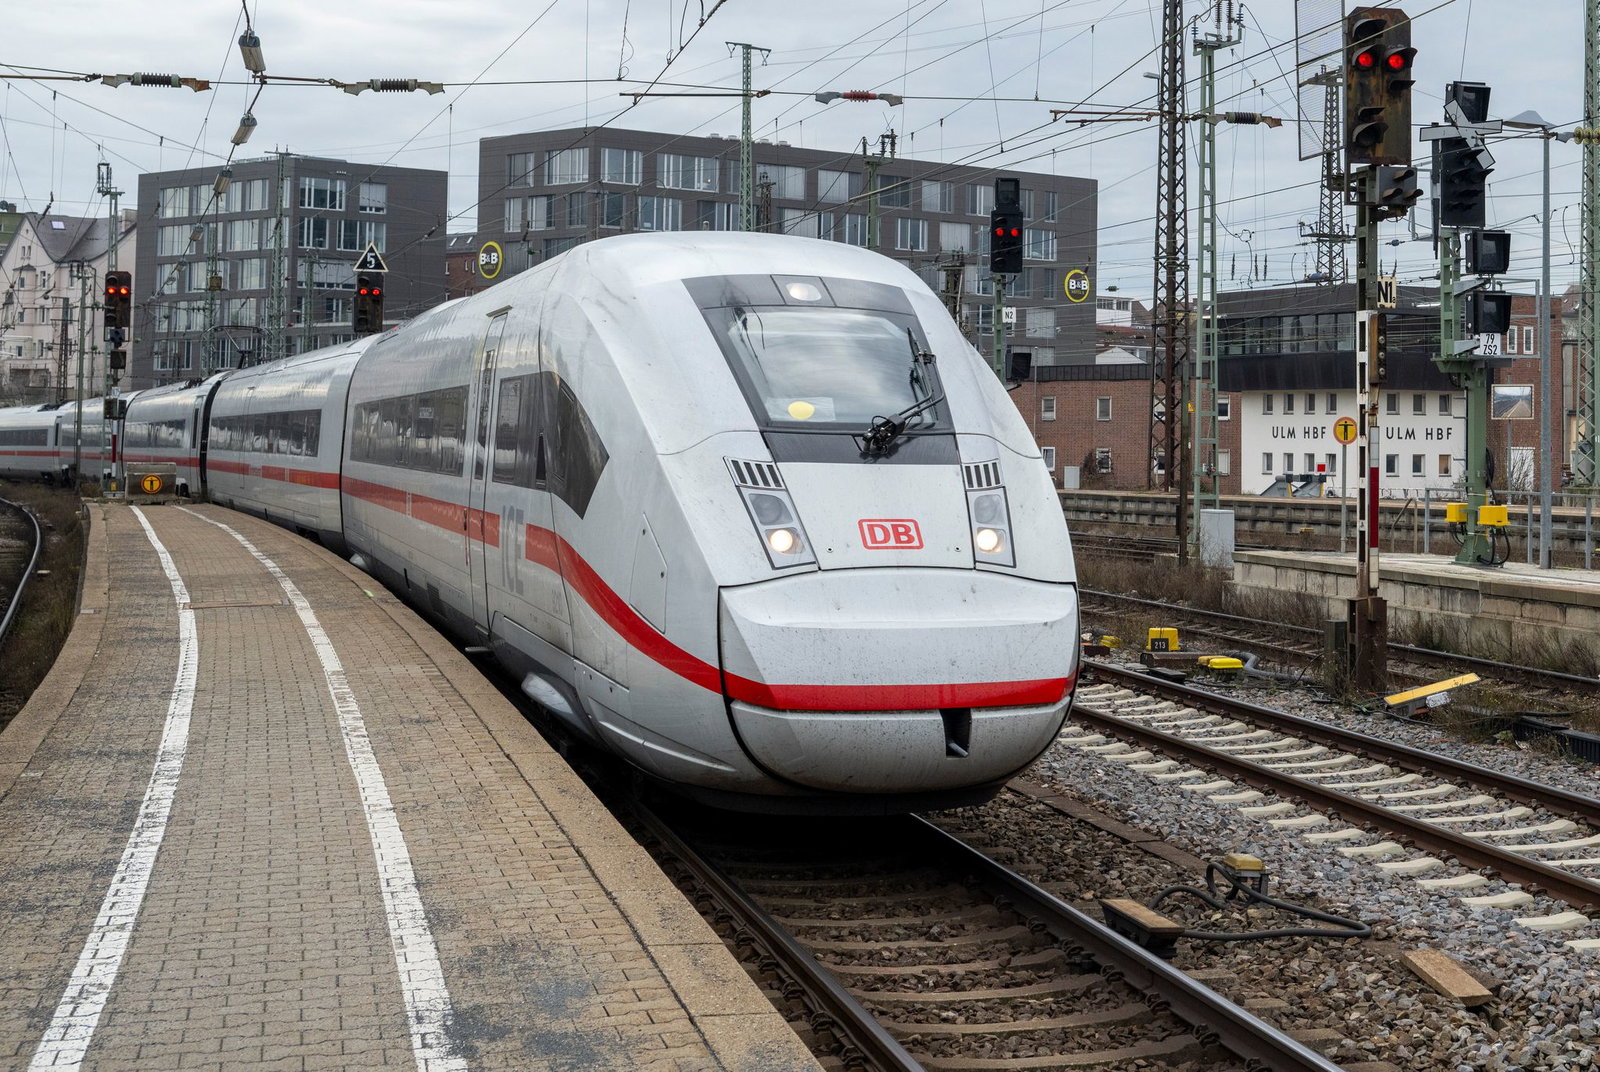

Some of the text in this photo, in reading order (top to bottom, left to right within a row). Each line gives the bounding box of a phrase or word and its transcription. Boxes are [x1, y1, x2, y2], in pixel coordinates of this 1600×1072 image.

[366, 252, 376, 269] 5
[480, 252, 498, 265] B&B
[1069, 279, 1088, 290] B&B
[1005, 311, 1014, 320] N2
[1486, 333, 1495, 344] 79
[1483, 344, 1498, 355] ZS2
[1272, 426, 1327, 439] ULM HBF
[1386, 427, 1453, 440] ULM HBF
[866, 523, 916, 545] DB
[501, 505, 525, 596] ICE
[1154, 641, 1166, 649] 213
